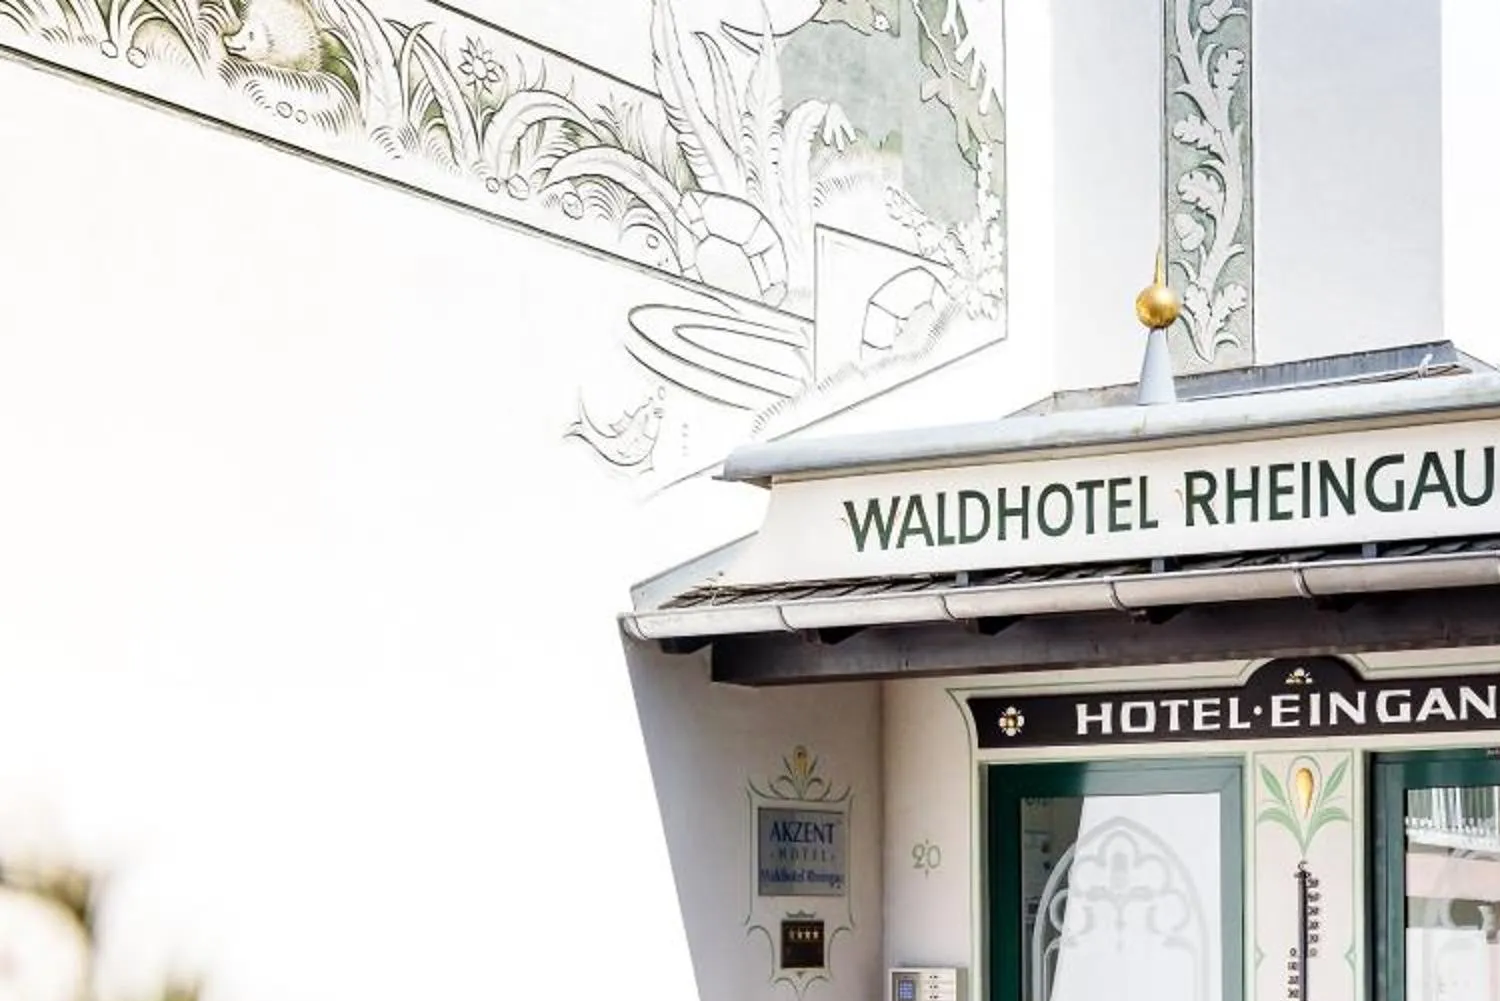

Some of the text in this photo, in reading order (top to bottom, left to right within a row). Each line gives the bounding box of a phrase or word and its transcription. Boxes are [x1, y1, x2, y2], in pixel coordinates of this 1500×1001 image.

[843, 446, 1496, 553] WALDHOTEL RHEINGAU
[769, 820, 835, 845] AKZENT
[911, 844, 942, 869] 20
